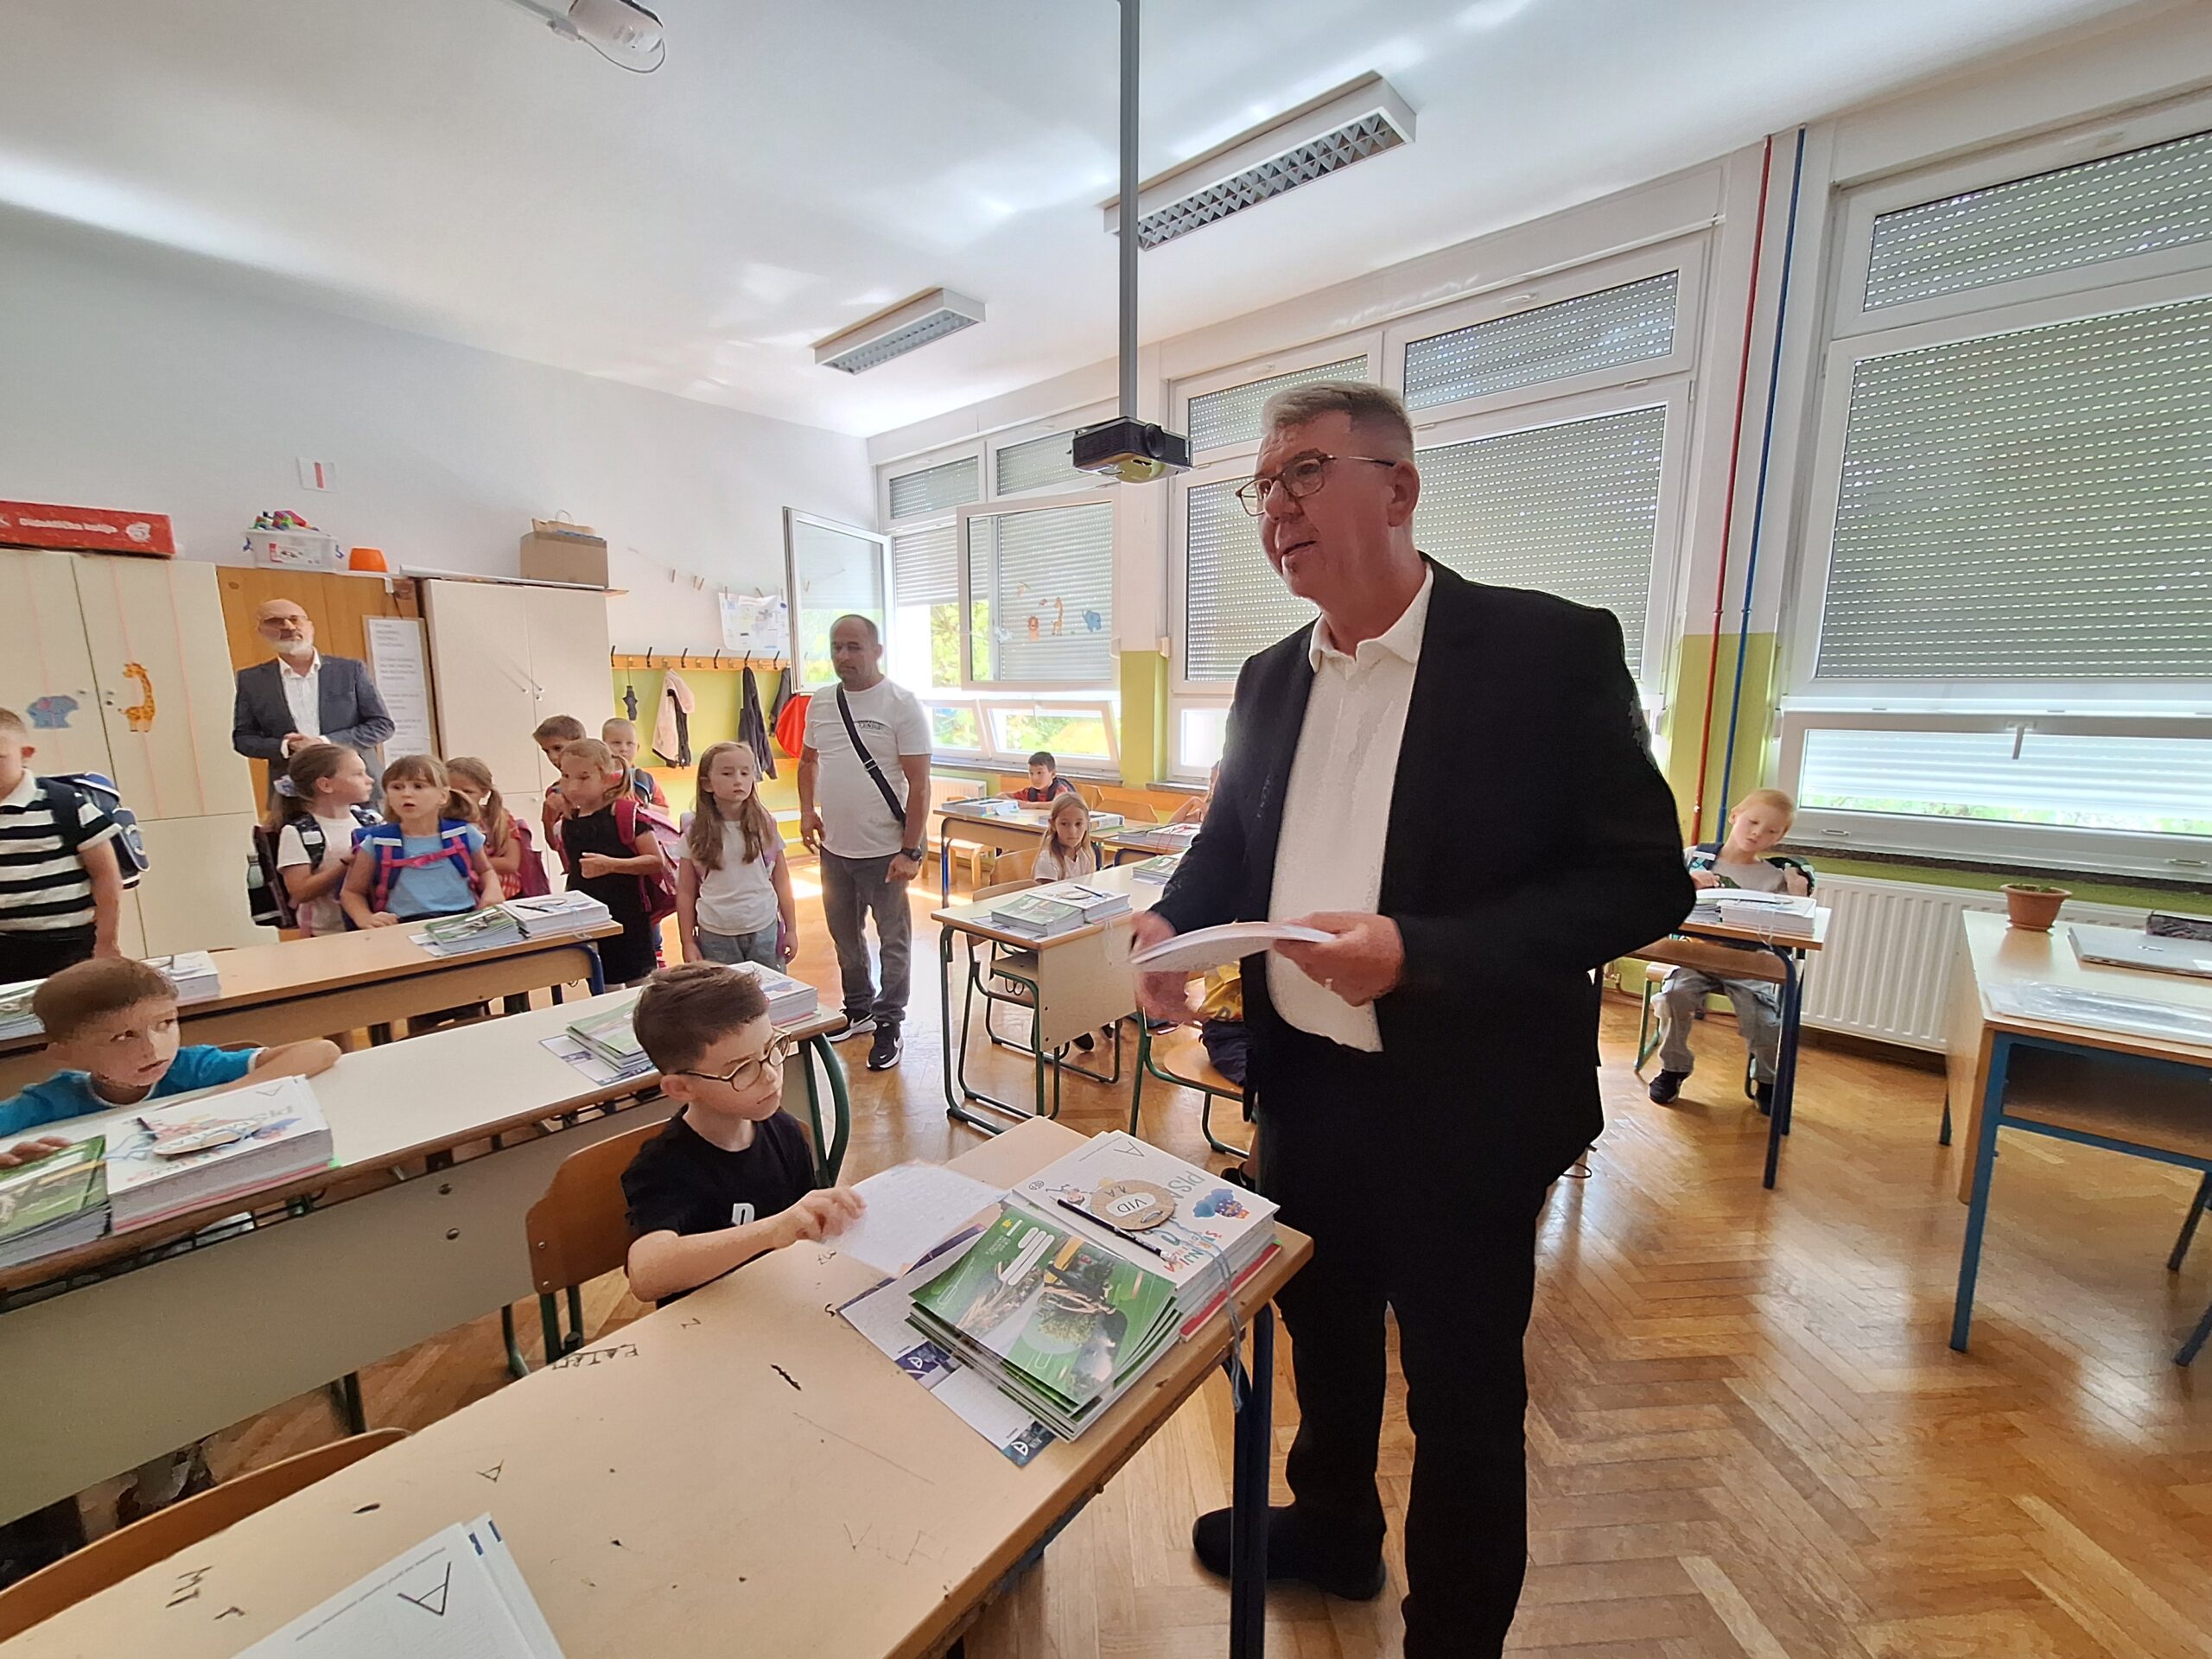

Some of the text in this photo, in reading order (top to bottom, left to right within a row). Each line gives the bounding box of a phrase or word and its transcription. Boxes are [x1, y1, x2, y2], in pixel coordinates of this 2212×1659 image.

[1113, 1141, 1145, 1157] A
[1116, 1198, 1147, 1213] VID
[397, 1560, 452, 1617] A
